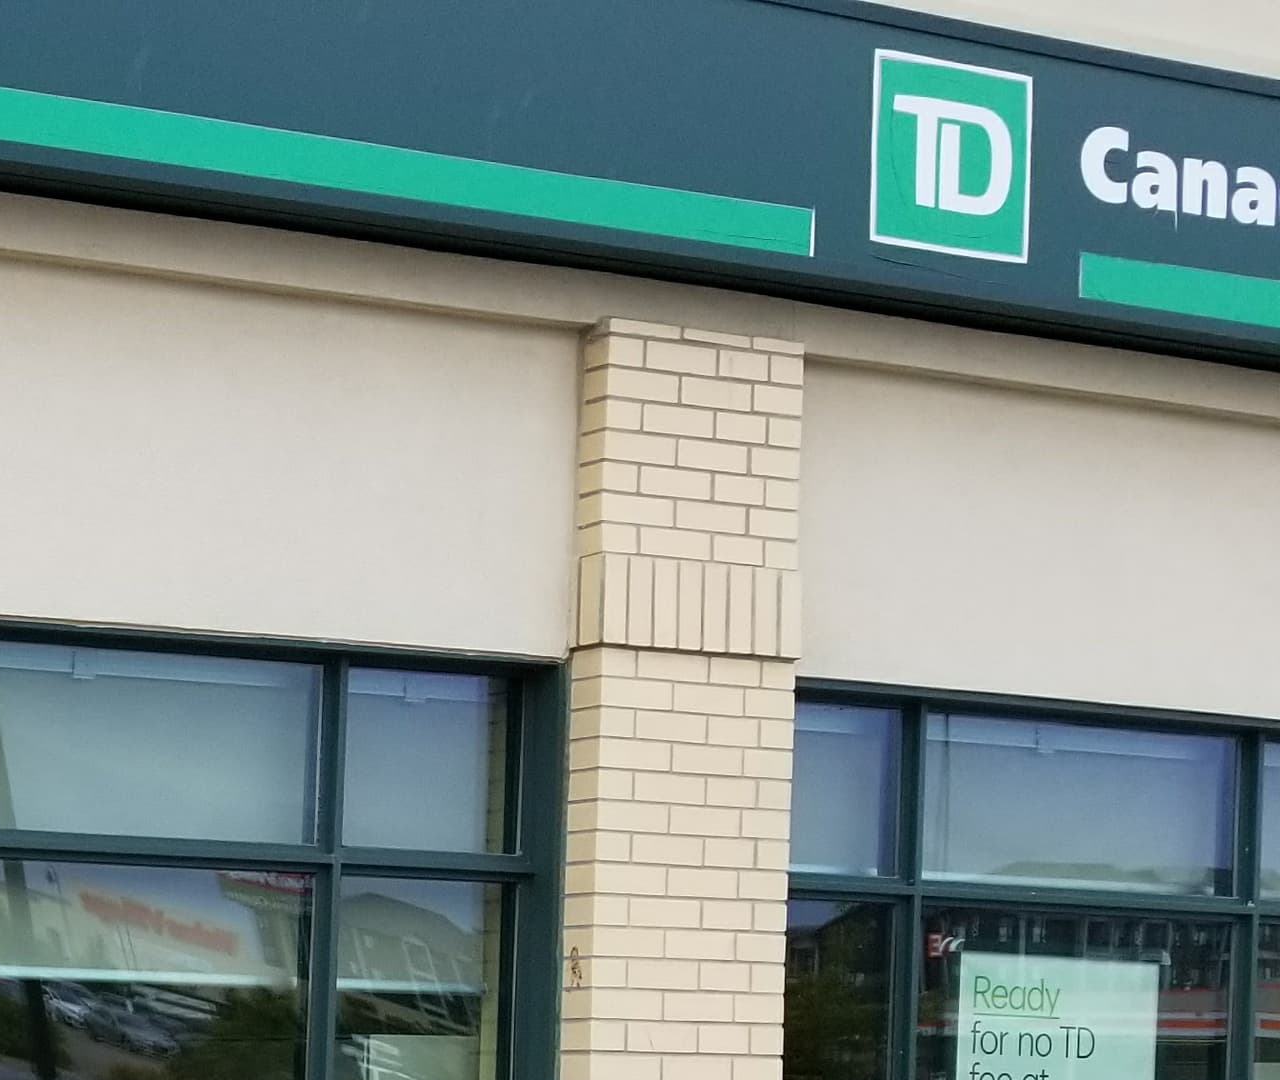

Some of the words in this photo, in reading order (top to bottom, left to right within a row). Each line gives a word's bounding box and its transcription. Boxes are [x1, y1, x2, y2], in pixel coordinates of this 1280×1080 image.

[893, 94, 1013, 216] TD
[1080, 126, 1280, 227] Cana
[972, 975, 1061, 1017] Ready
[971, 1020, 1009, 1055] for
[1018, 1031, 1052, 1058] no
[1059, 1025, 1096, 1059] TD
